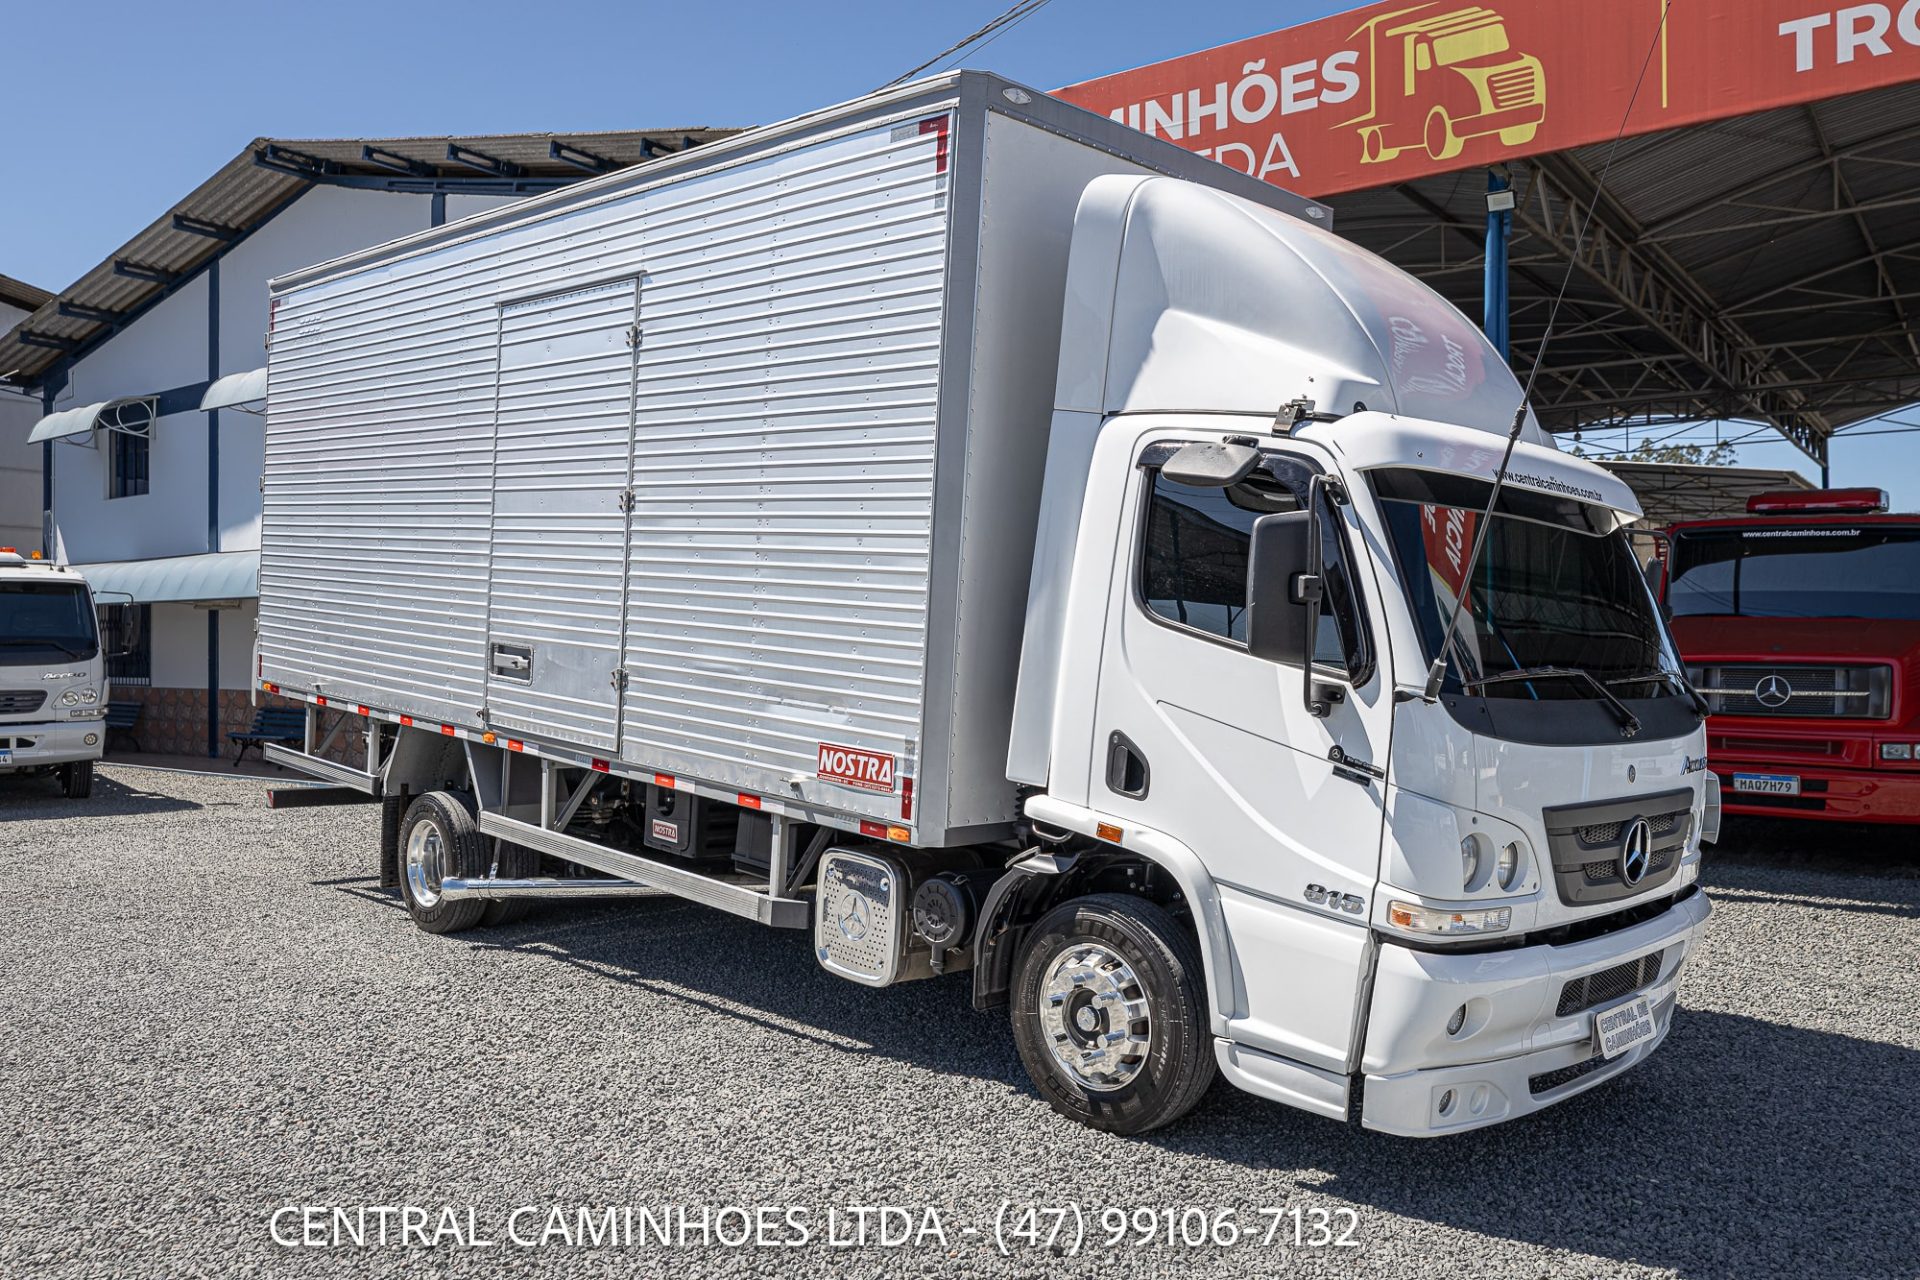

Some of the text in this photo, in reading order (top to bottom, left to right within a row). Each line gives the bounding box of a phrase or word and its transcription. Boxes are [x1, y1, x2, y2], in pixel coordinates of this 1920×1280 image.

[1109, 50, 1360, 140] INHÕES
[1492, 468, 1603, 502] ww.centralcaminhoes.com.br
[1742, 529, 1860, 538] www.centralcaminhoes.com.br
[819, 749, 892, 784] NOSTRA
[654, 824, 676, 838] NOSTRA
[1600, 1000, 1649, 1034] CENTRAL DE
[1605, 1019, 1651, 1052] CAMINHÕES
